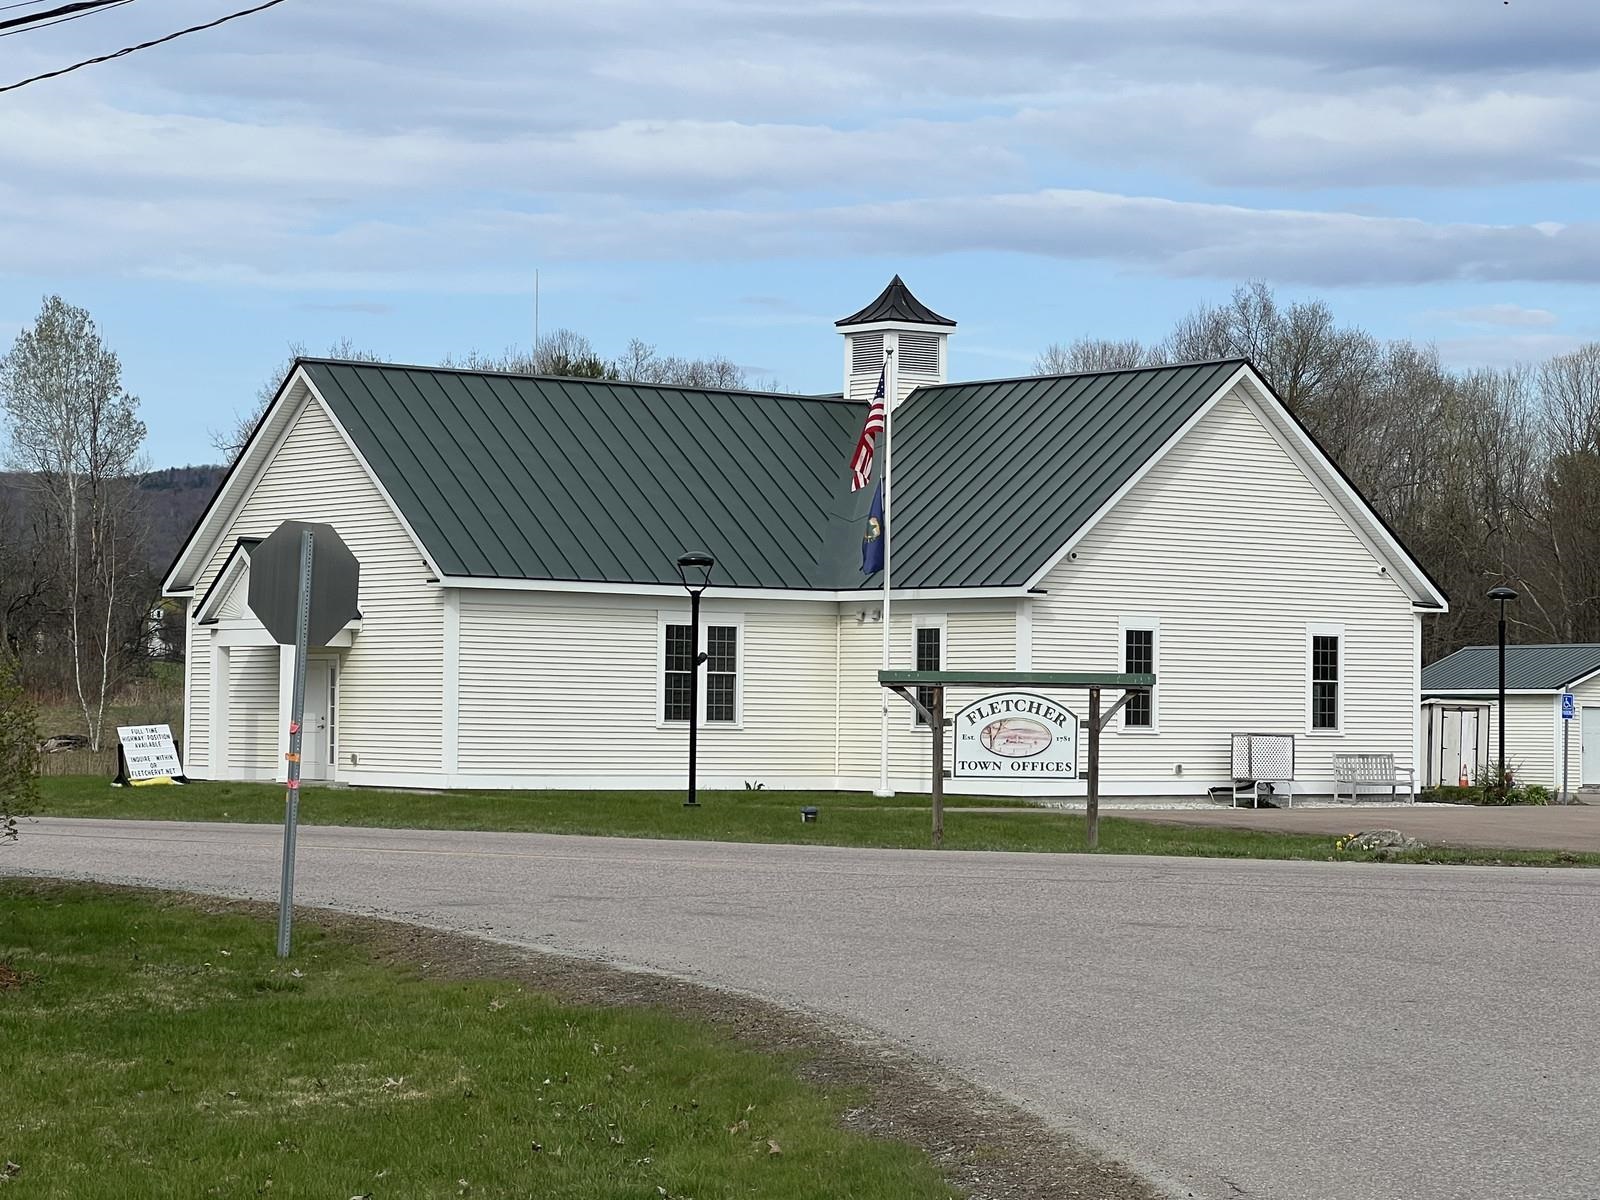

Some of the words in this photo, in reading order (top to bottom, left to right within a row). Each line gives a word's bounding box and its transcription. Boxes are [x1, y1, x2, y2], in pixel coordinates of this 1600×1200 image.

[966, 700, 1067, 728] FLETCHER
[147, 733, 171, 741] POSITION
[958, 761, 1002, 770] TOWN
[1010, 761, 1072, 772] OFFICES
